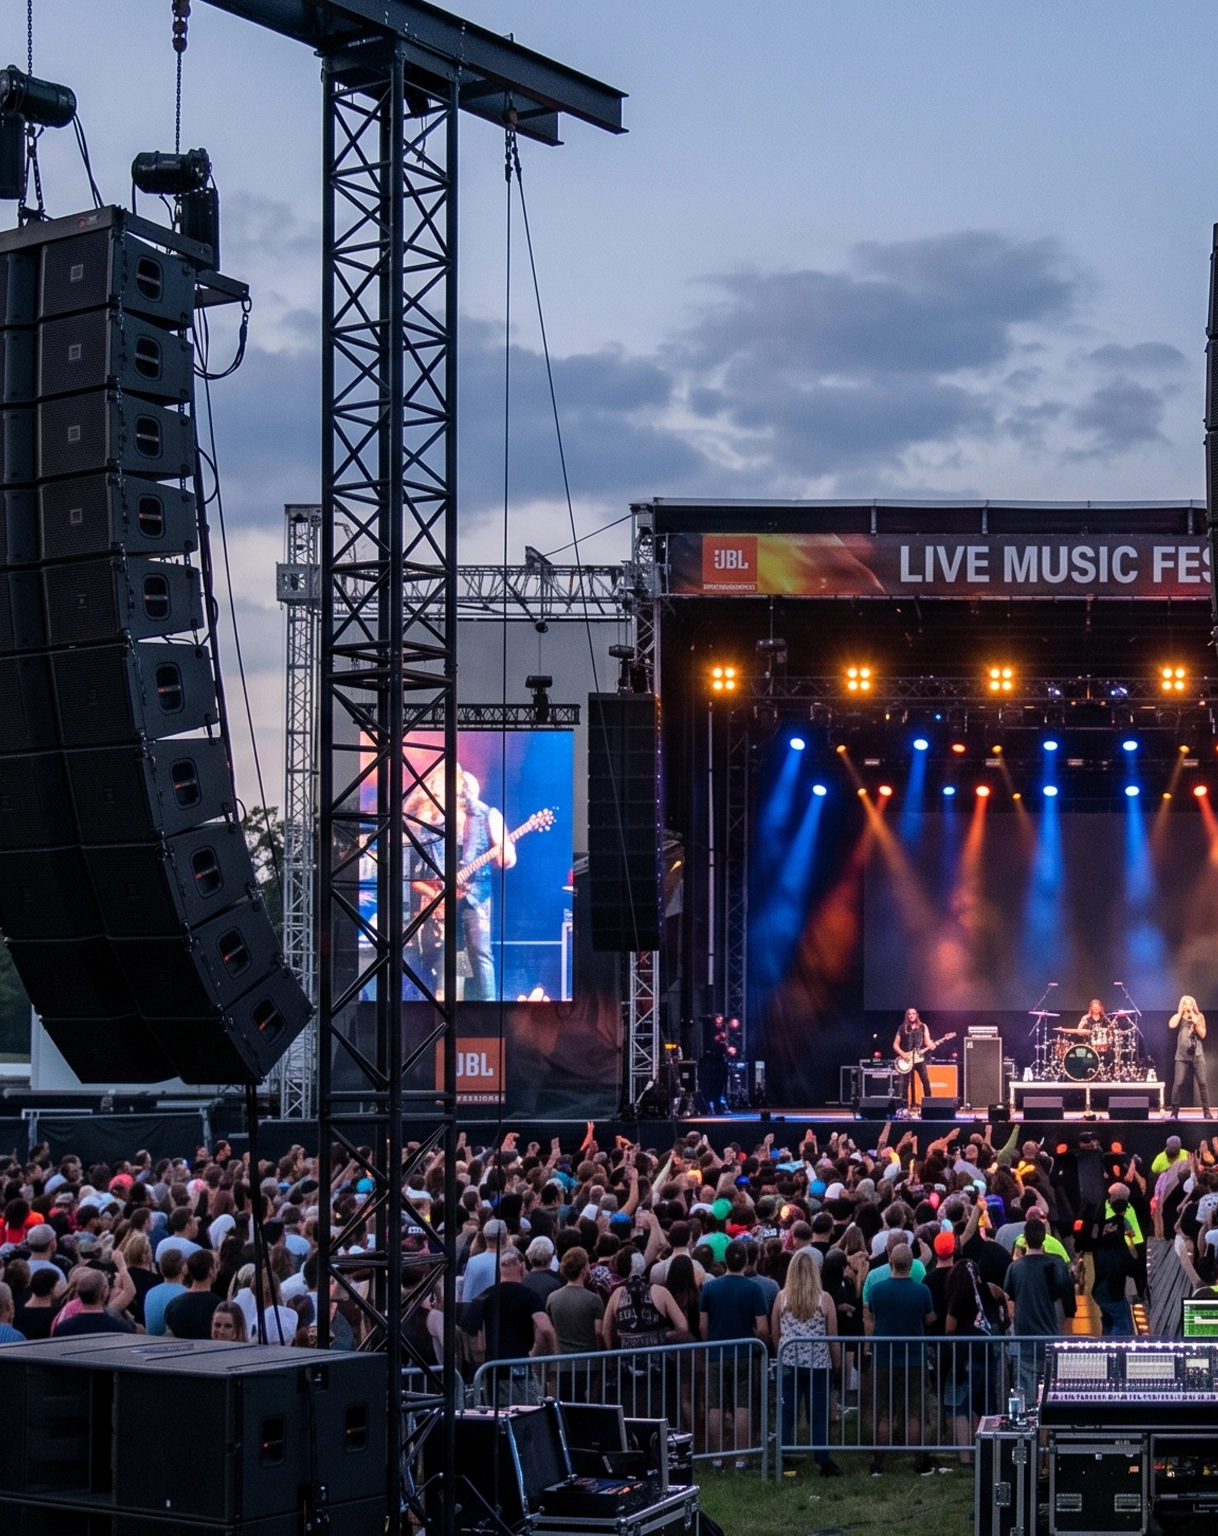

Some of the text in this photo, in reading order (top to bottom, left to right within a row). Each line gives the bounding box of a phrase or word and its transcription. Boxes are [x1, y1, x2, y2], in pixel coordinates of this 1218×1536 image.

[714, 549, 749, 570] JBL
[900, 545, 990, 583] LIVE
[1003, 545, 1138, 584] MUSIC
